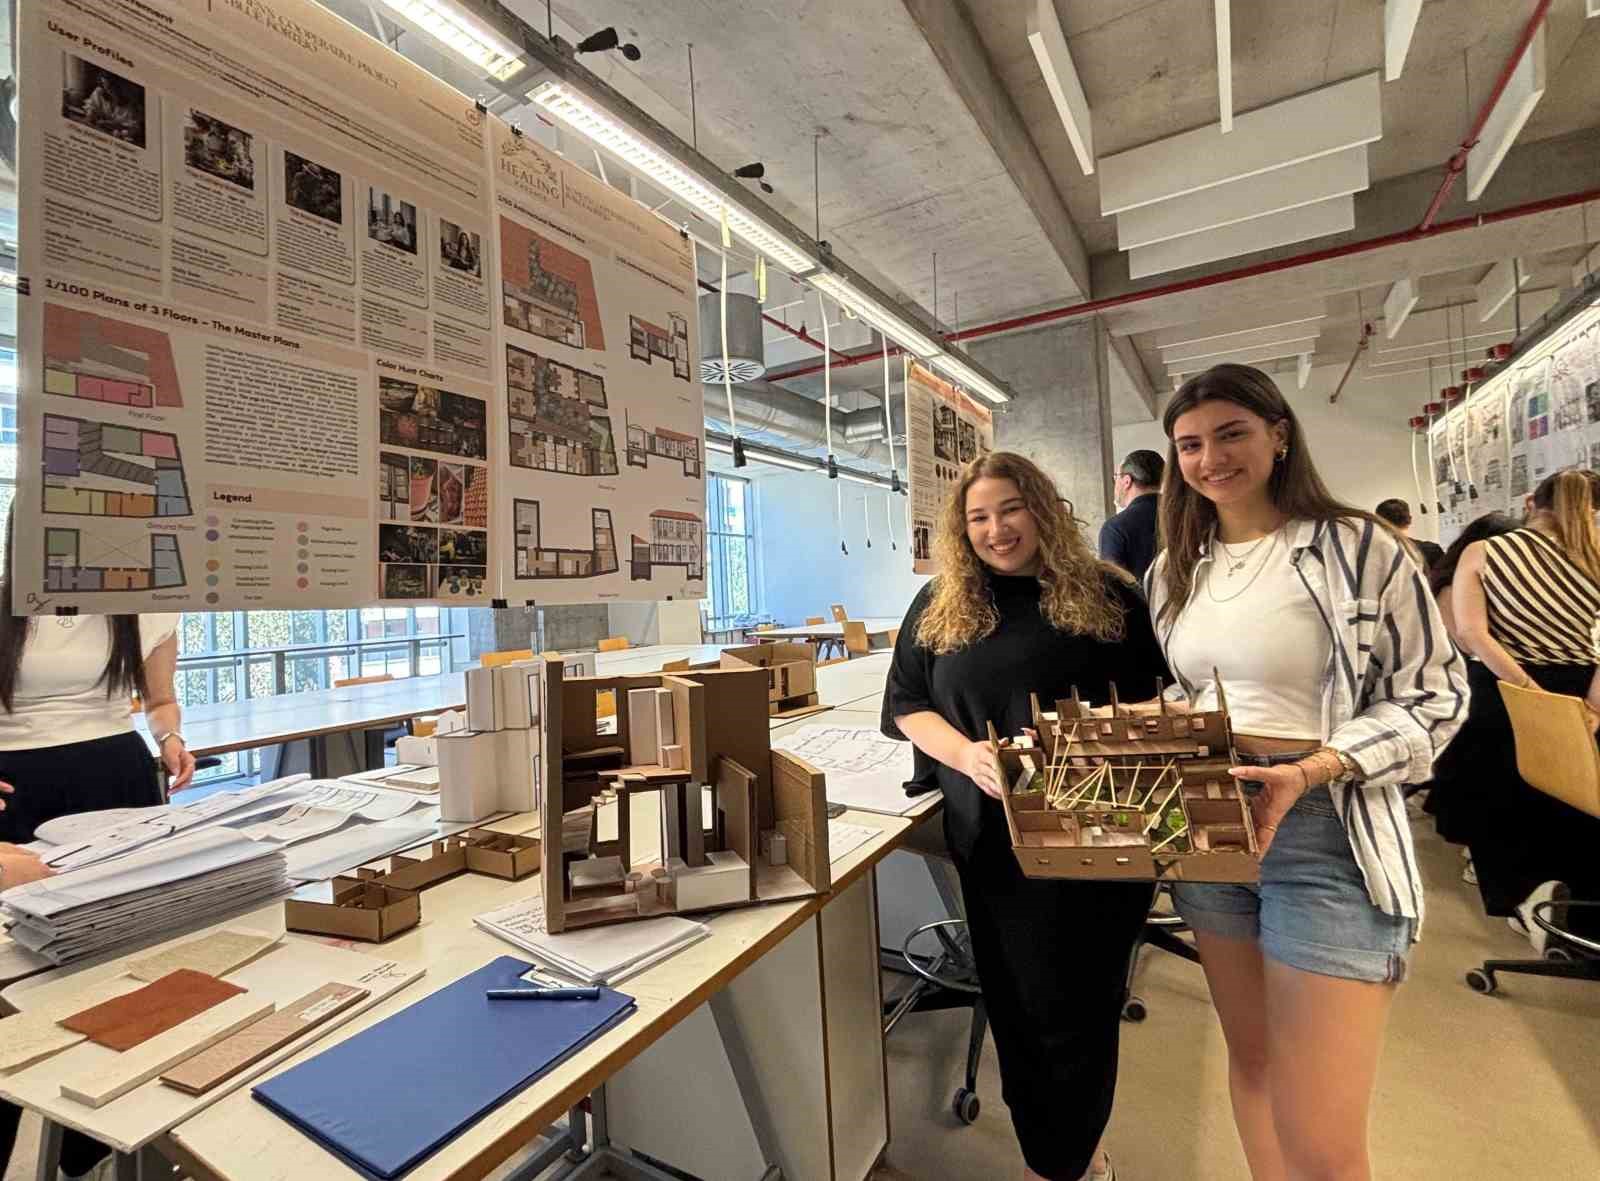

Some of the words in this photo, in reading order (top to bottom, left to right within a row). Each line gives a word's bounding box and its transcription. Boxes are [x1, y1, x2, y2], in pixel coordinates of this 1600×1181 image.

[47, 20, 80, 42] User
[83, 37, 135, 68] Profiles
[500, 158, 560, 199] HEALING
[45, 278, 89, 298] 1/100
[94, 290, 130, 309] Plans
[134, 302, 147, 313] of
[151, 305, 160, 315] 3
[162, 308, 199, 325] Floors
[211, 320, 232, 333] The
[234, 325, 271, 343] Master
[273, 334, 301, 350] Plans
[376, 359, 397, 370] Color
[419, 369, 444, 382] Charts
[213, 491, 253, 504] Legend
